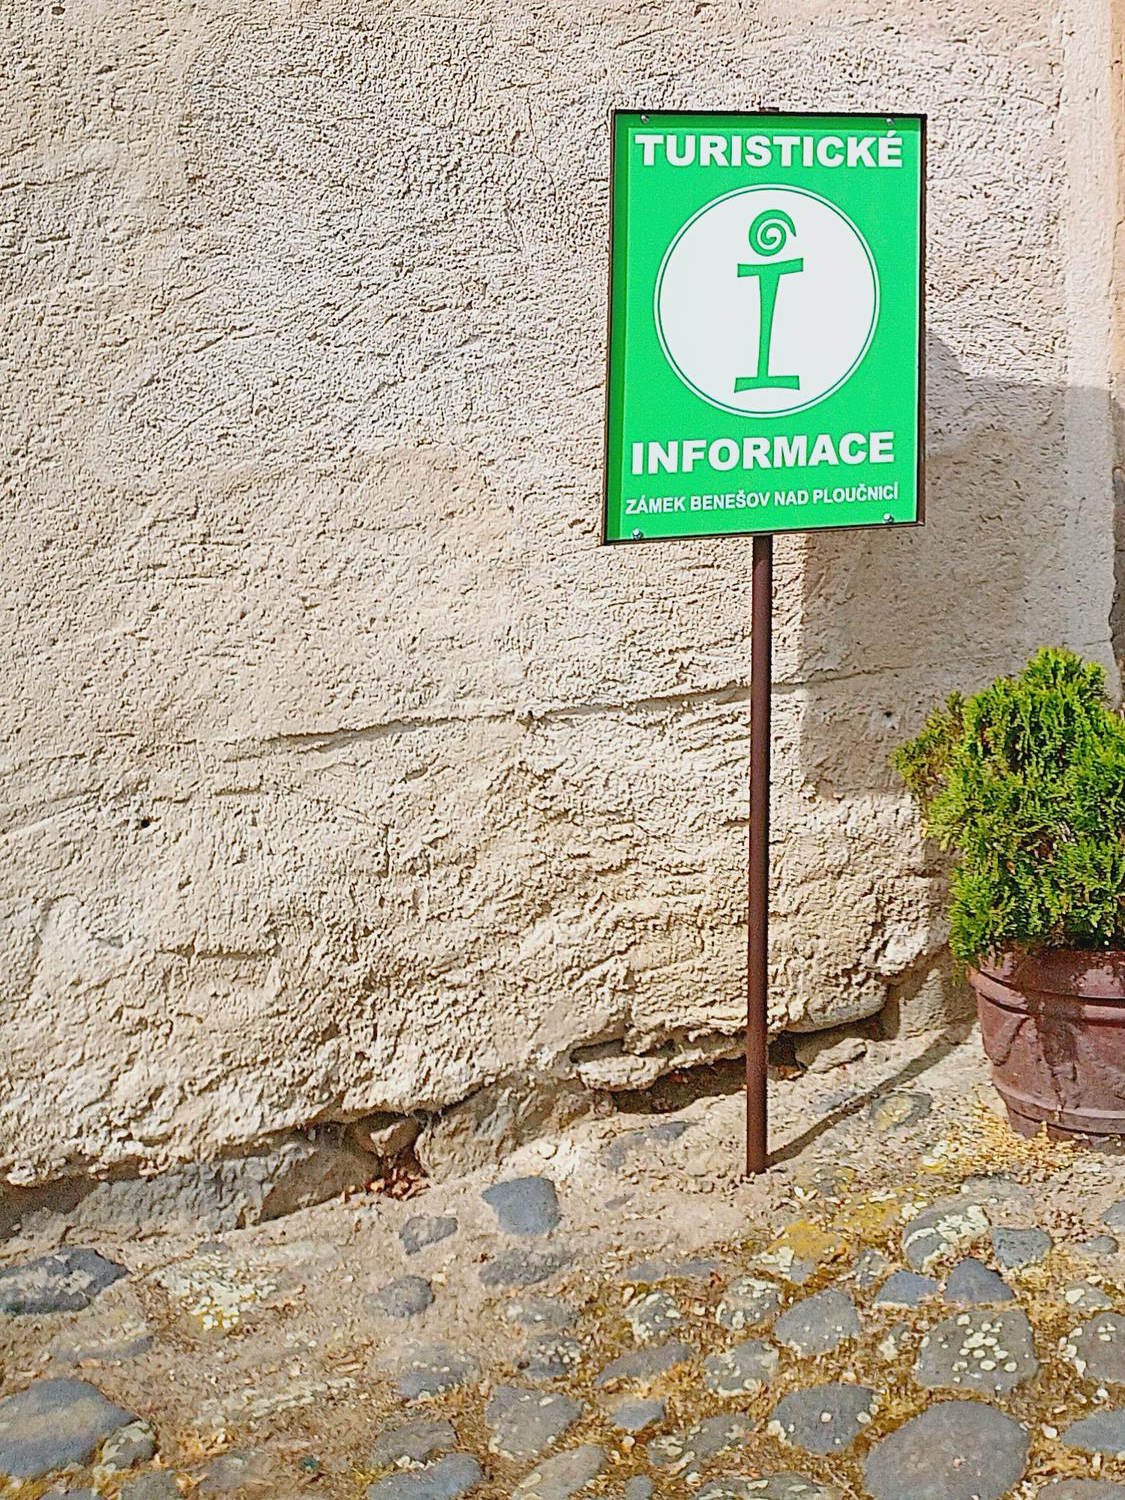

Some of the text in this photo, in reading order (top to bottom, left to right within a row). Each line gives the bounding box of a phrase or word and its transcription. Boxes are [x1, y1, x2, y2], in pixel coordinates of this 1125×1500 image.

[634, 131, 903, 167] TURISTICKÉ
[631, 431, 895, 476] INFORMACE
[625, 482, 899, 515] ZÁMEK BENEŠOV NAD PLOUČNICÍ
